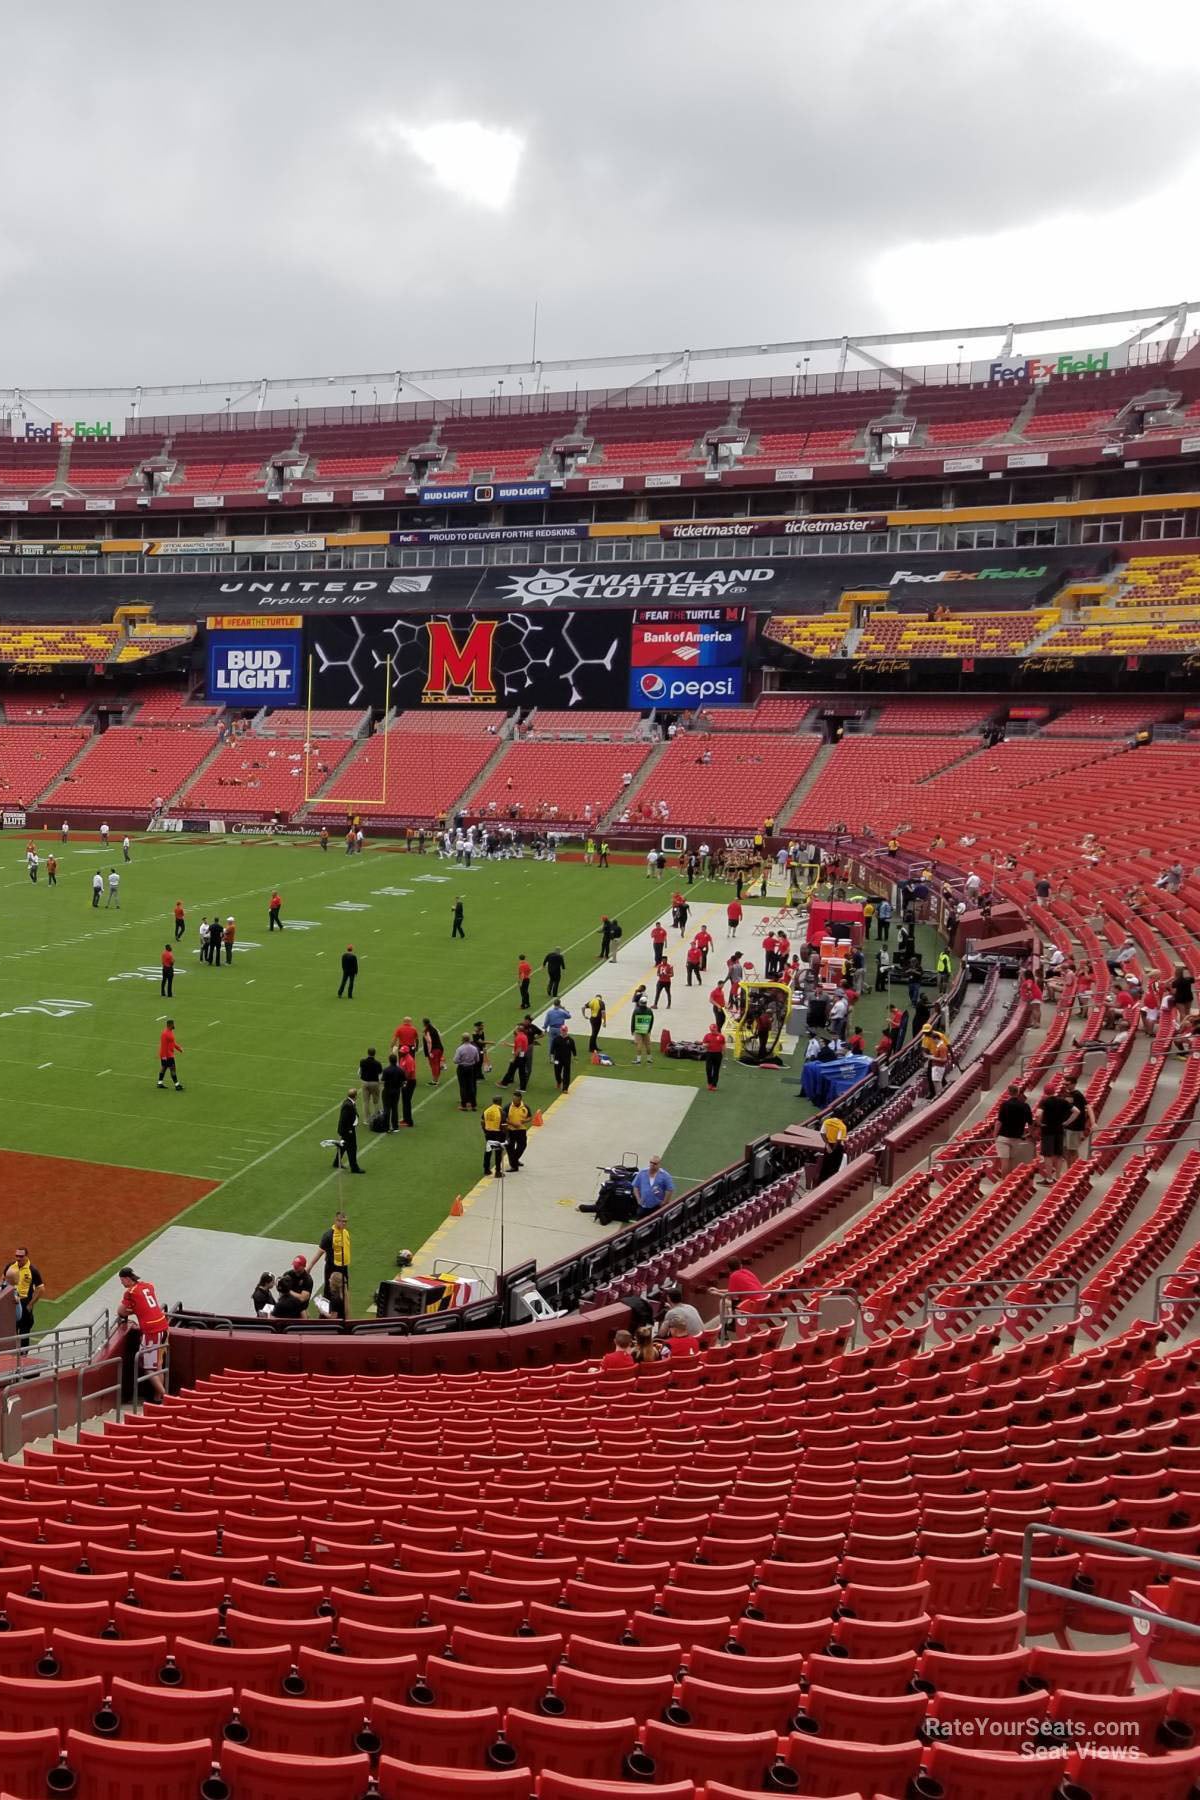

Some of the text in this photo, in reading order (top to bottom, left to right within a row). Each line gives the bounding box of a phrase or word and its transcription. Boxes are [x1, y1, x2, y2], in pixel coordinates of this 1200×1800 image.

[989, 351, 1109, 382] FedExField
[25, 421, 112, 438] FedExField
[424, 490, 469, 500] BUD LIGHT
[499, 486, 546, 497] BUD LIGHT
[673, 523, 753, 538] ticketmaster
[785, 519, 870, 533] ticketmaster
[429, 533, 455, 542] PROUD
[457, 532, 467, 541] TO
[468, 531, 500, 540] DELIVER
[502, 530, 517, 539] FOR
[518, 529, 533, 538] THE
[300, 539, 318, 549] sas
[590, 568, 775, 586] MARYLAND
[889, 565, 1049, 586] FedExField
[219, 581, 378, 593] UNITED
[584, 582, 736, 598] LOTTERY
[258, 595, 367, 606] Proud to fly
[643, 630, 732, 644] Bank of America
[227, 650, 281, 670] BUD
[422, 620, 498, 693] M
[216, 669, 291, 689] LIGHT
[670, 677, 733, 699] pepsi
[142, 1288, 157, 1308] 6
